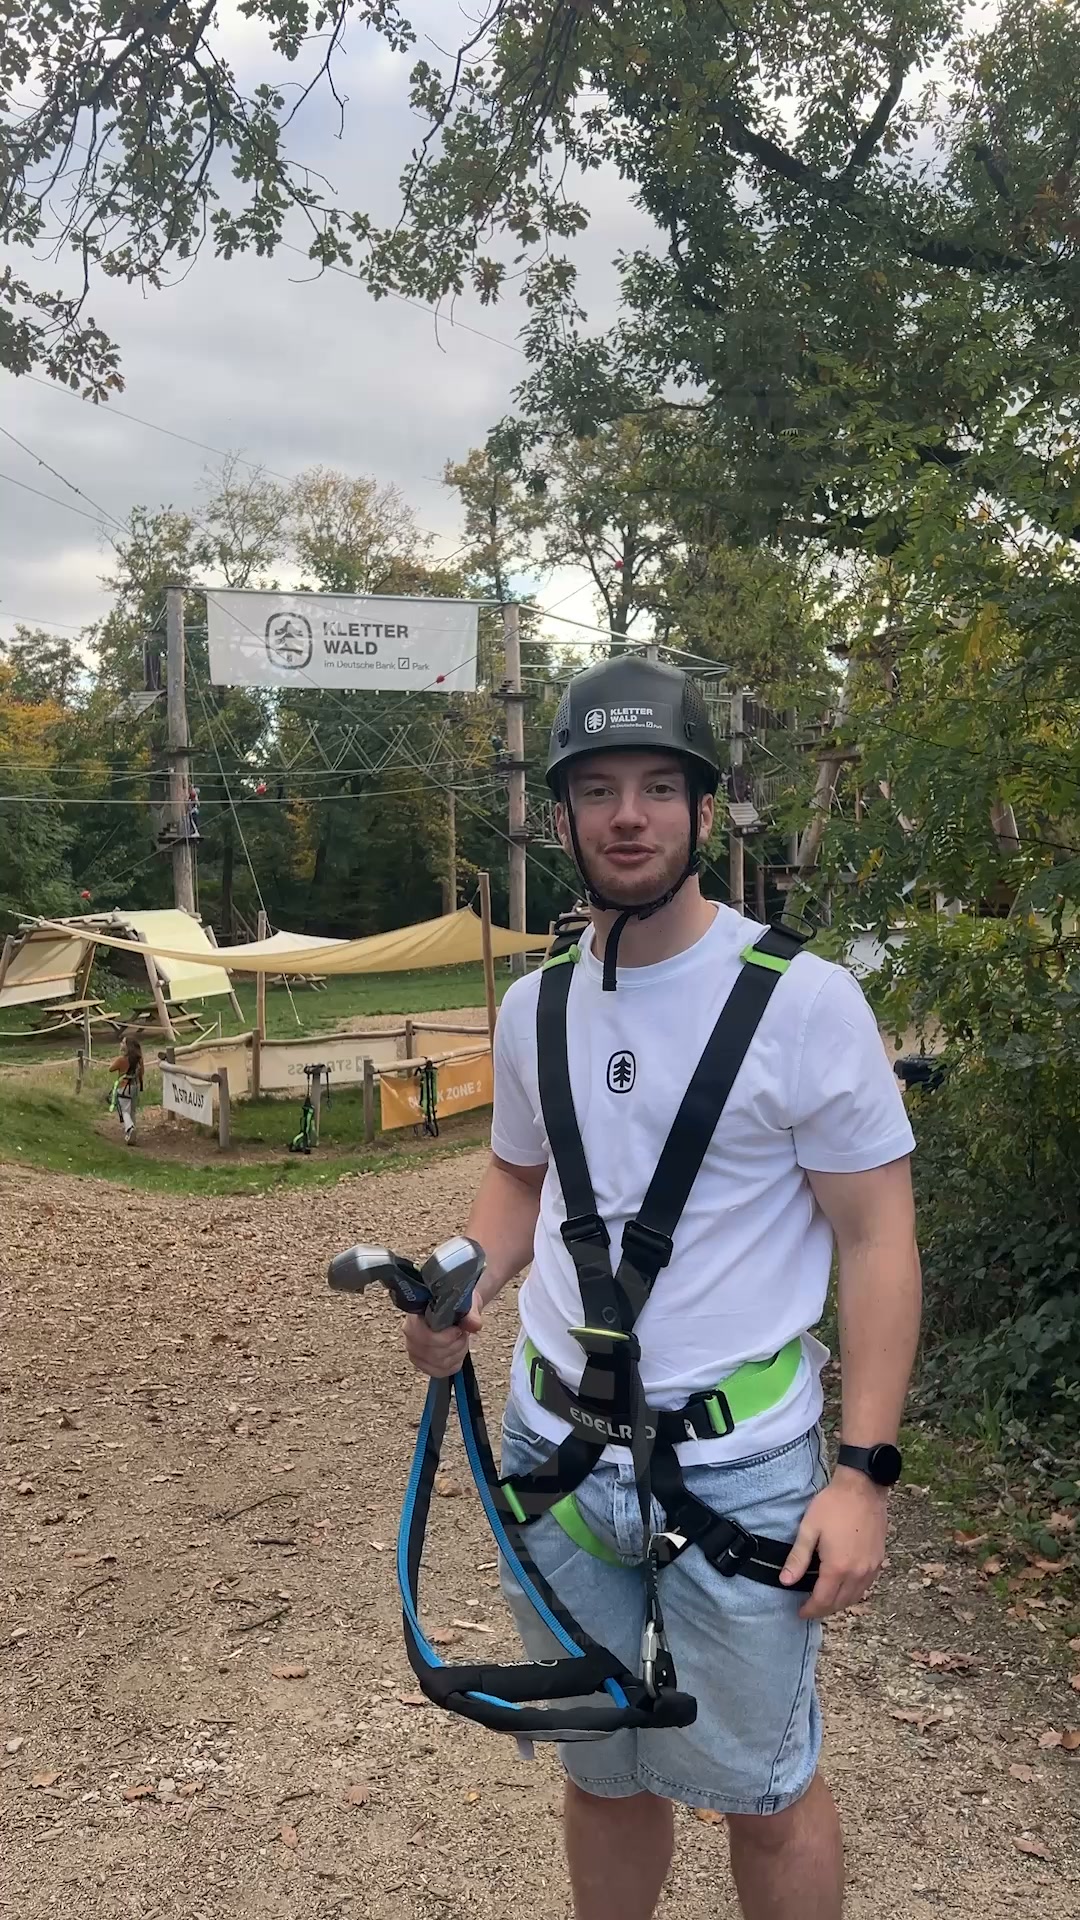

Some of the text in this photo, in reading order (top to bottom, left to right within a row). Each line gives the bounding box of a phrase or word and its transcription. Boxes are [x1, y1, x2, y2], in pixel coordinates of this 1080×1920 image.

[323, 621, 408, 638] KLETTER
[323, 639, 378, 655] WALD
[324, 660, 430, 670] im Deutsche Bank Park
[610, 707, 653, 715] KLETTER
[610, 715, 637, 723] WALD
[446, 1081, 475, 1100] ZONE
[476, 1080, 482, 1093] 2
[569, 1406, 657, 1440] EDELRD
